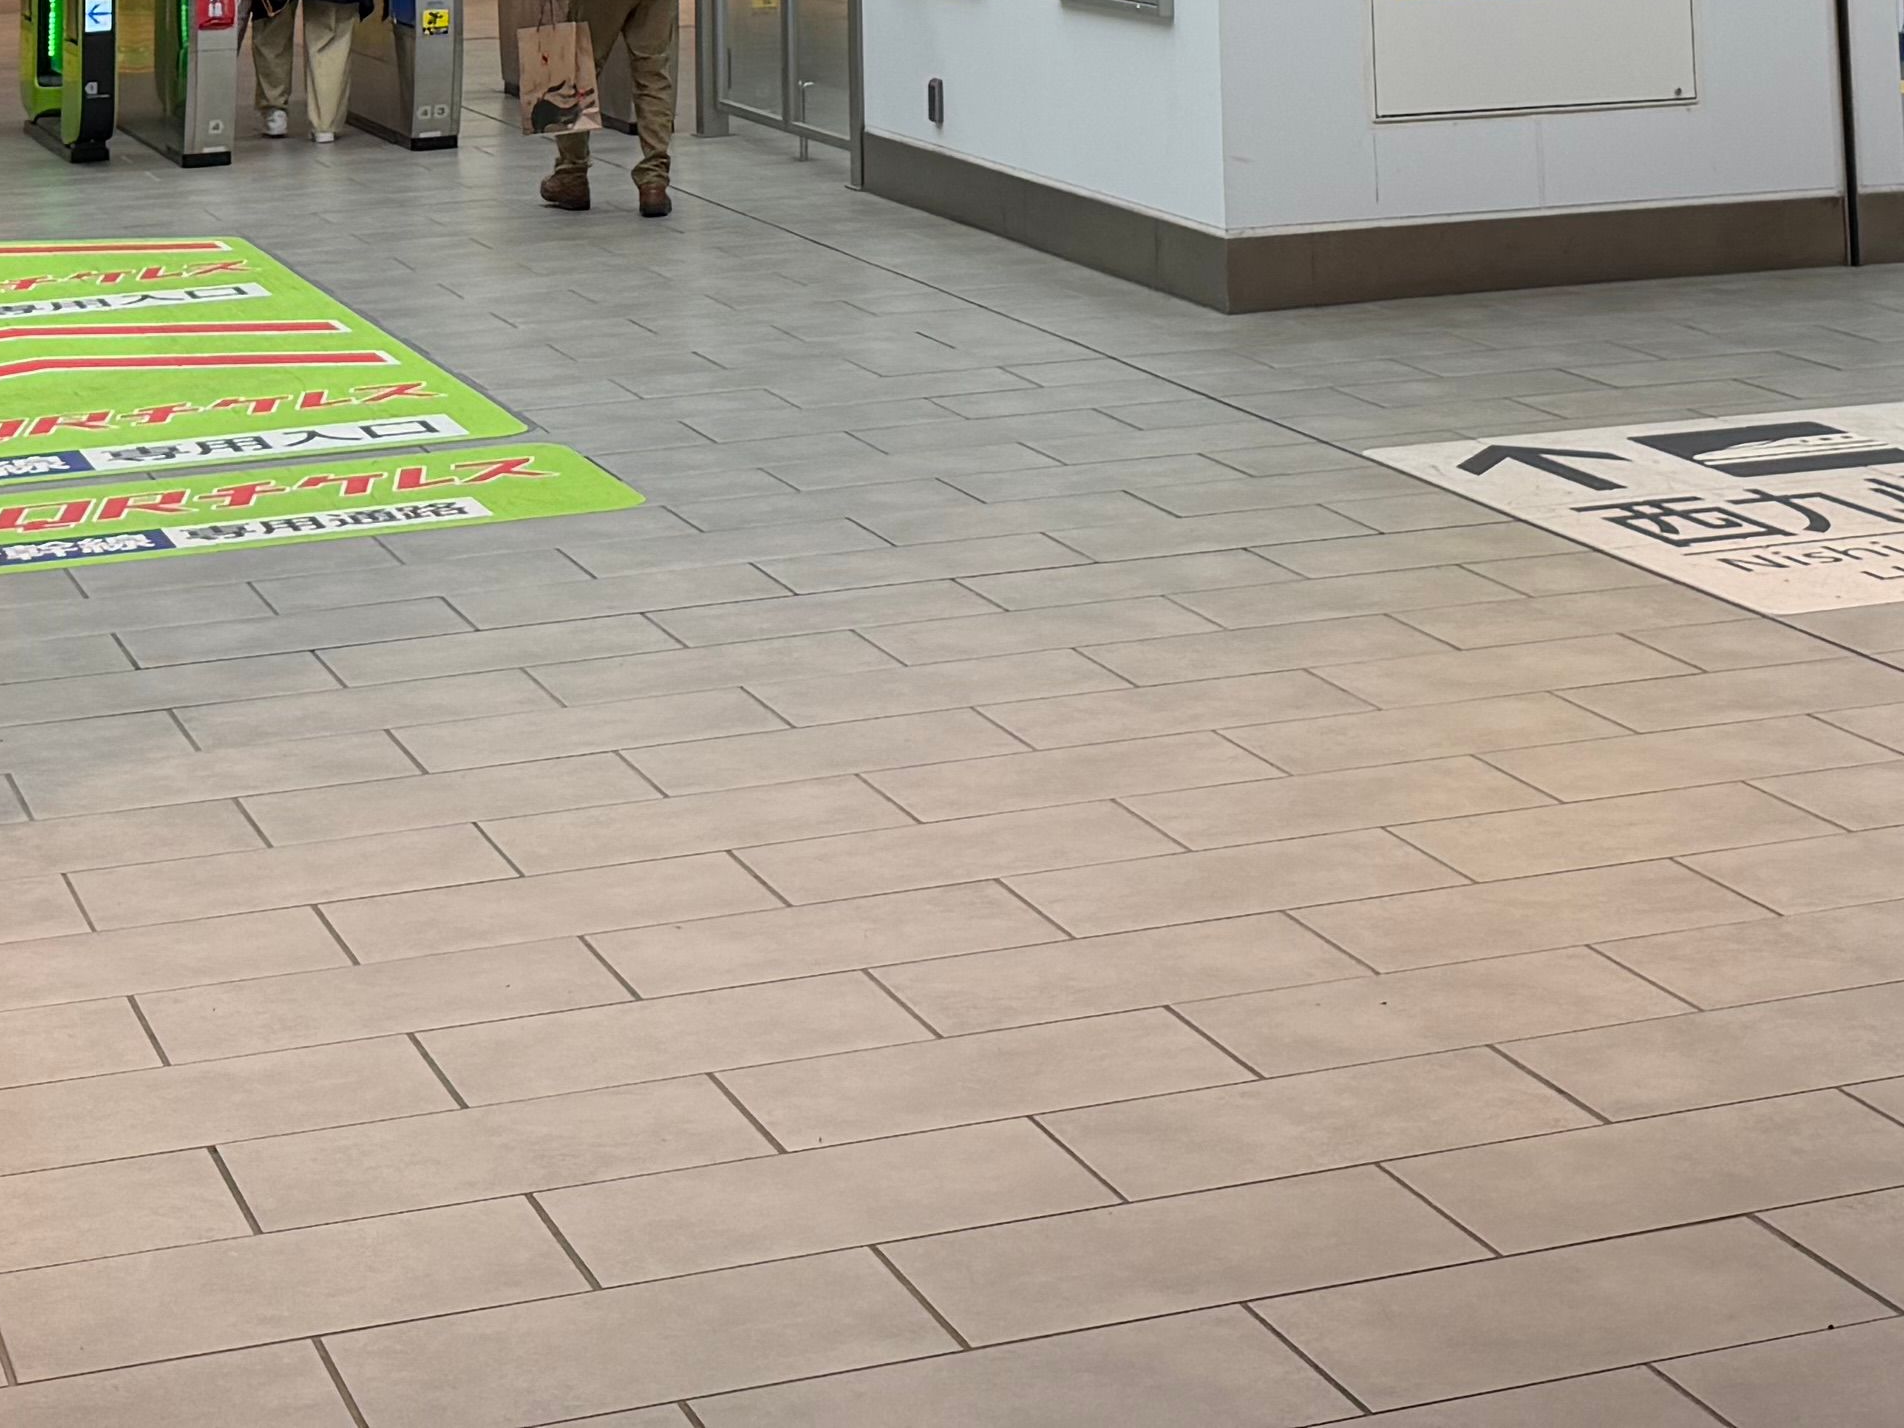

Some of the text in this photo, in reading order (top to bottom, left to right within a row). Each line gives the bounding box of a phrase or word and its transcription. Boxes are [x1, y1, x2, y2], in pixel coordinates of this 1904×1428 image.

[108, 419, 438, 463] 専用入口
[180, 498, 470, 543] 専用通路
